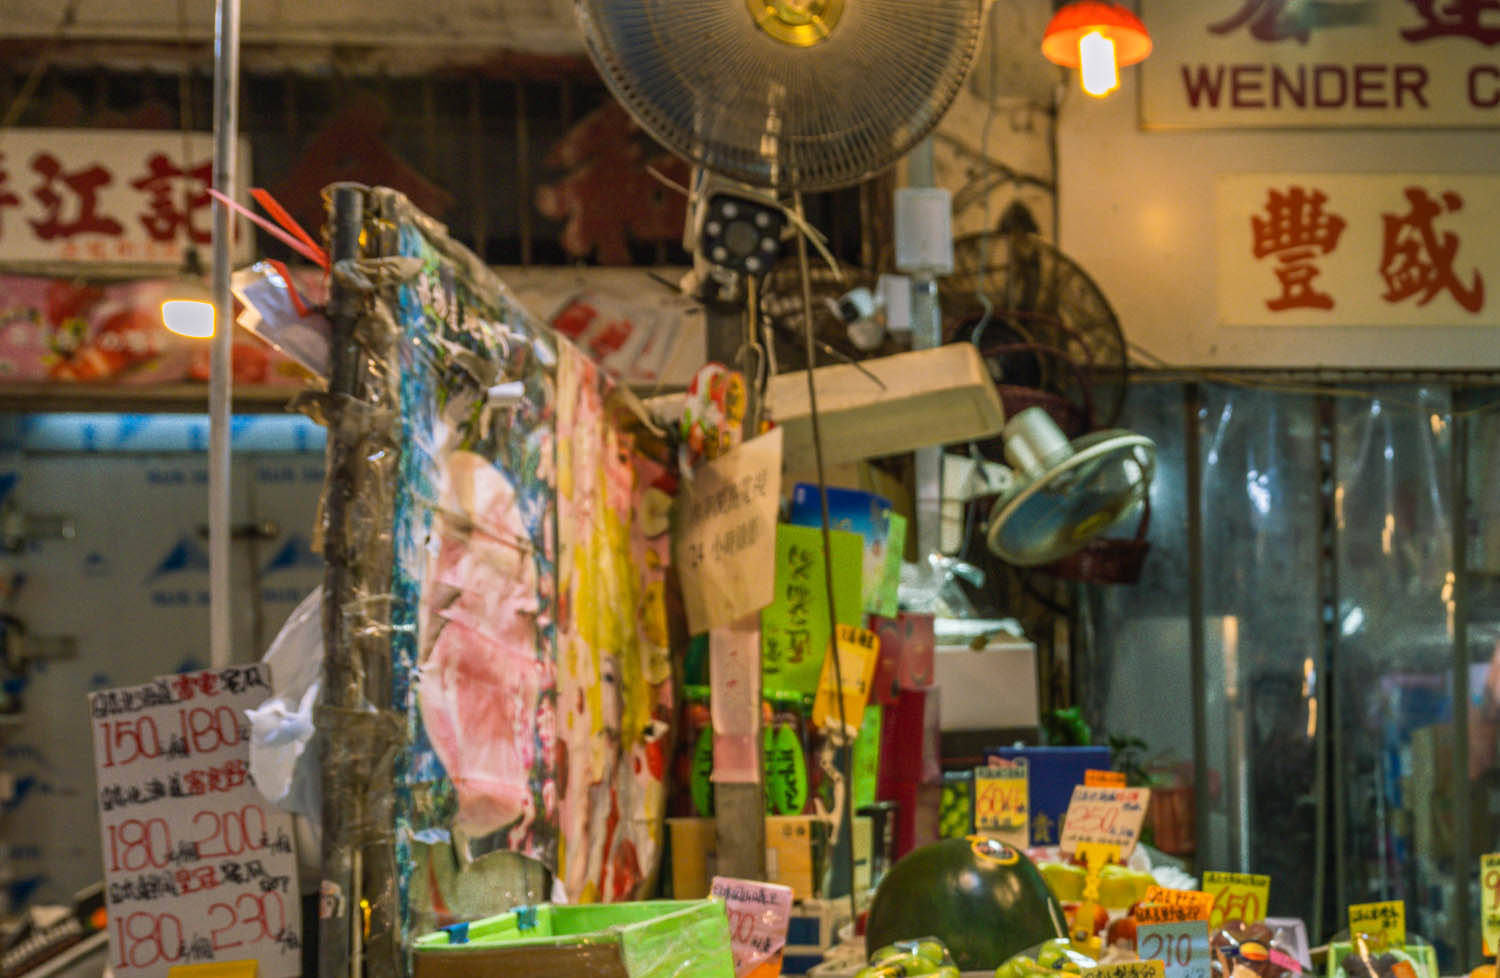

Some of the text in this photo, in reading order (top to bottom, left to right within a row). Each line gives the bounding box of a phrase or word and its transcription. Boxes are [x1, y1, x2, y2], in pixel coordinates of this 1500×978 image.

[1182, 64, 1430, 110] WENDER
[1249, 185, 1486, 314] 豐盛
[192, 804, 269, 859] 200
[207, 890, 286, 951] 230
[1141, 932, 1193, 967] 210
